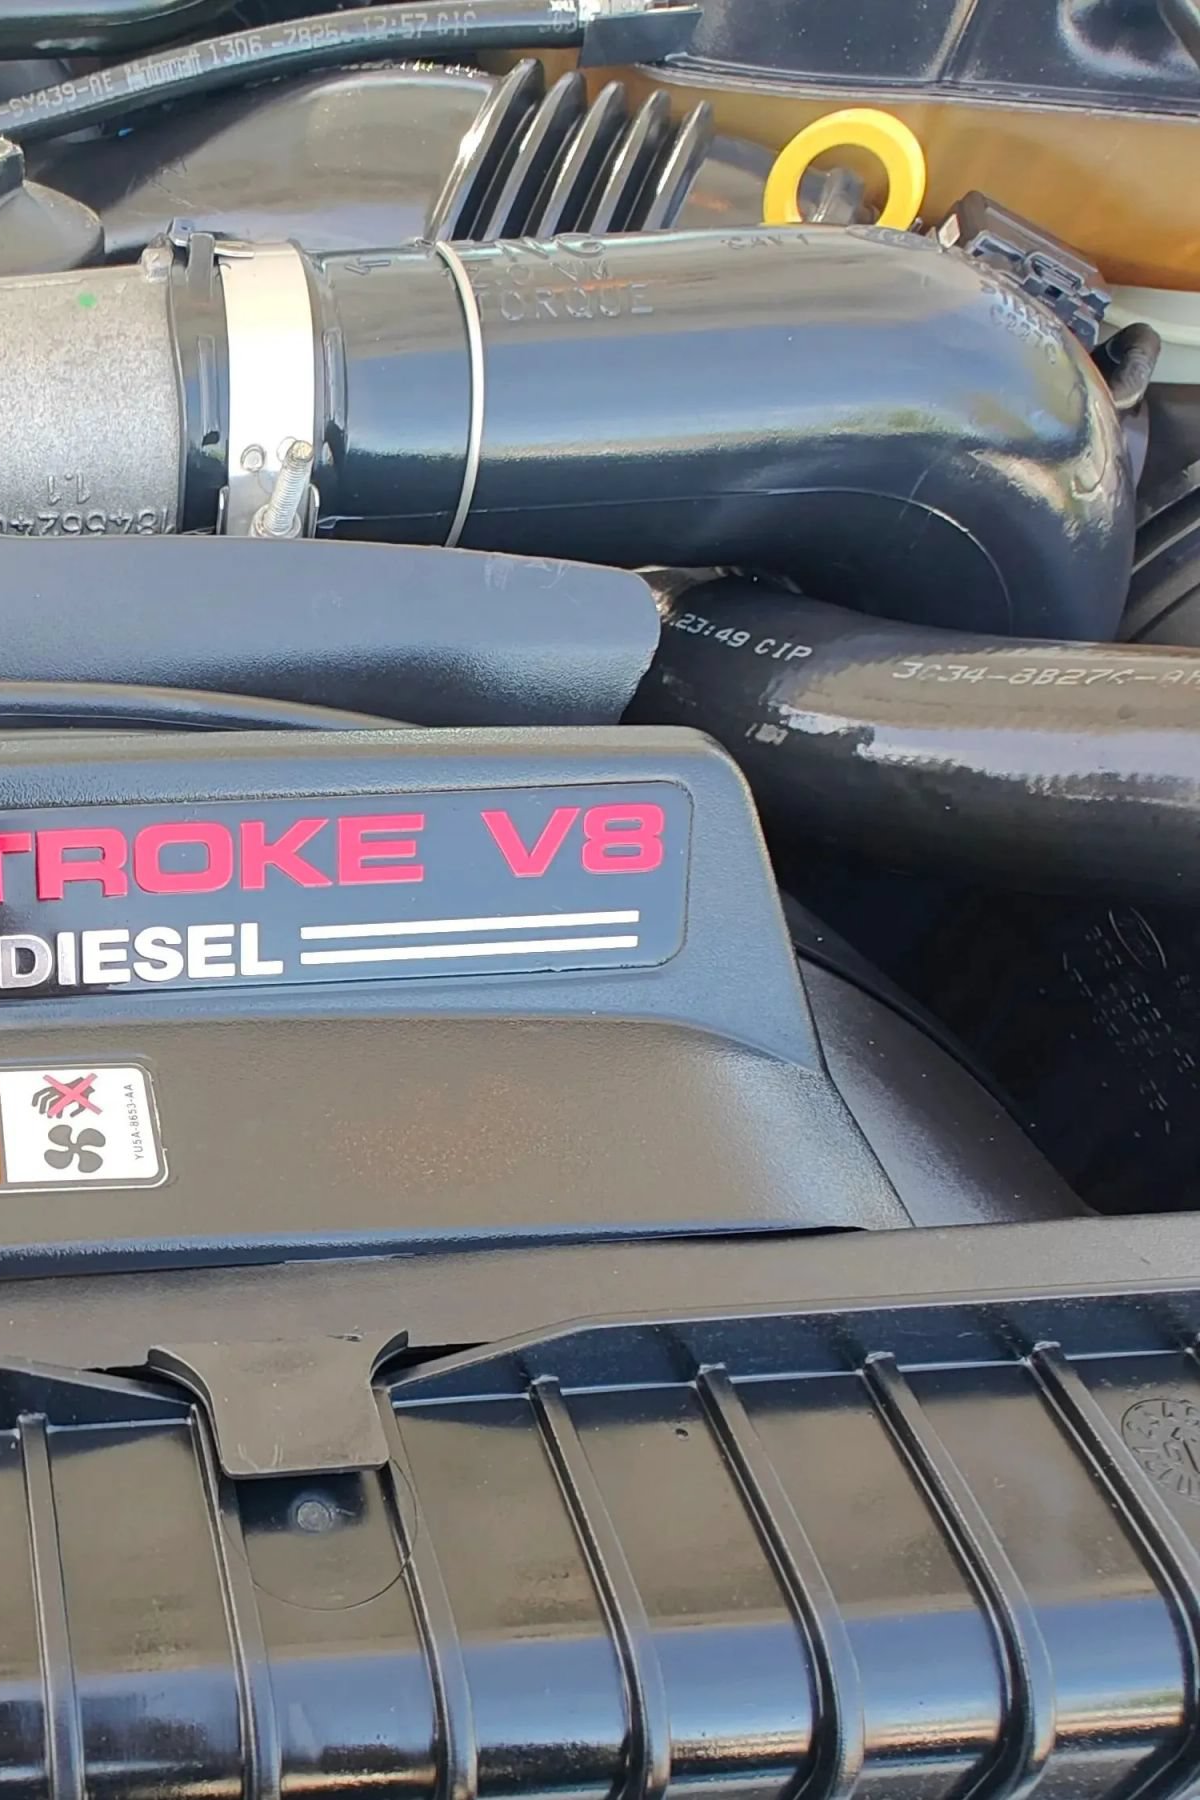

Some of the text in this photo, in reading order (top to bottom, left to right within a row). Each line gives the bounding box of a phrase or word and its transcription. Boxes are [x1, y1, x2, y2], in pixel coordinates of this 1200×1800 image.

[754, 638, 814, 662] CIP
[480, 803, 664, 878] V8
[0, 922, 284, 990] DIESEL
[122, 1083, 145, 1161] YU5A-8653-AA
